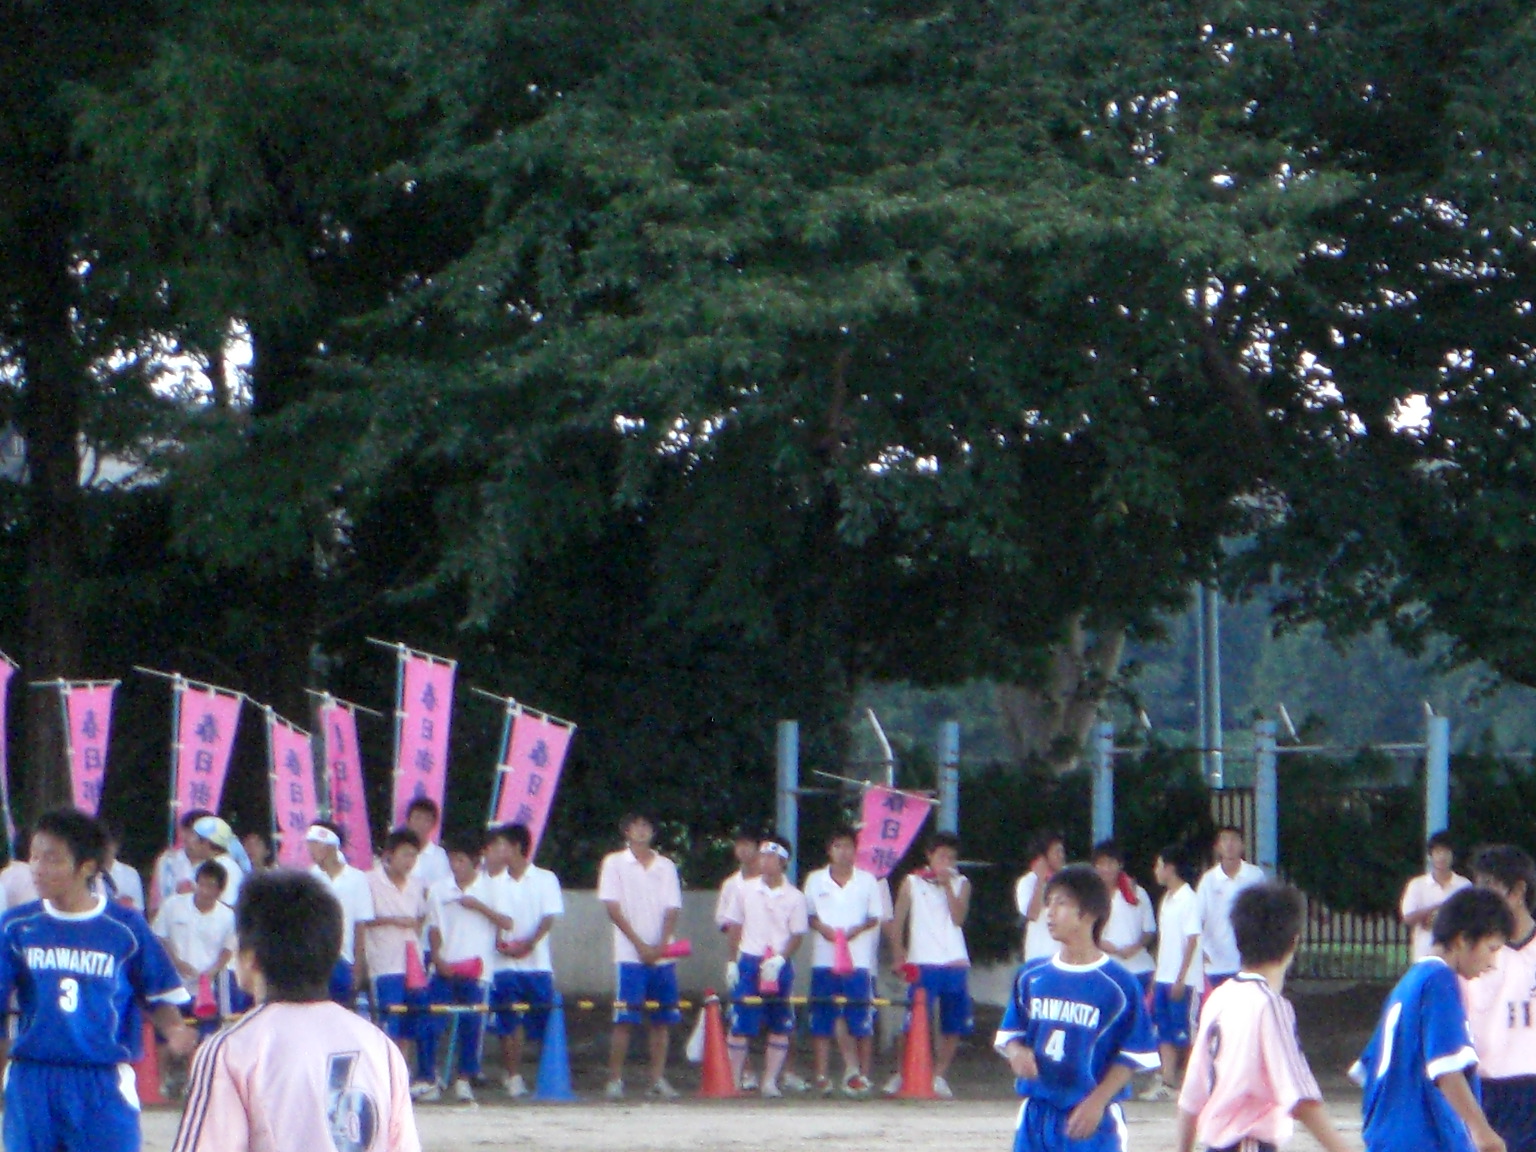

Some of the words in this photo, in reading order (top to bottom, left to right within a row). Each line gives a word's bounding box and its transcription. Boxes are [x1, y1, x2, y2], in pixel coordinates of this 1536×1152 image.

[58, 977, 79, 1013] 3
[1027, 997, 1100, 1030] RAWAKITA
[1044, 1029, 1067, 1062] 4
